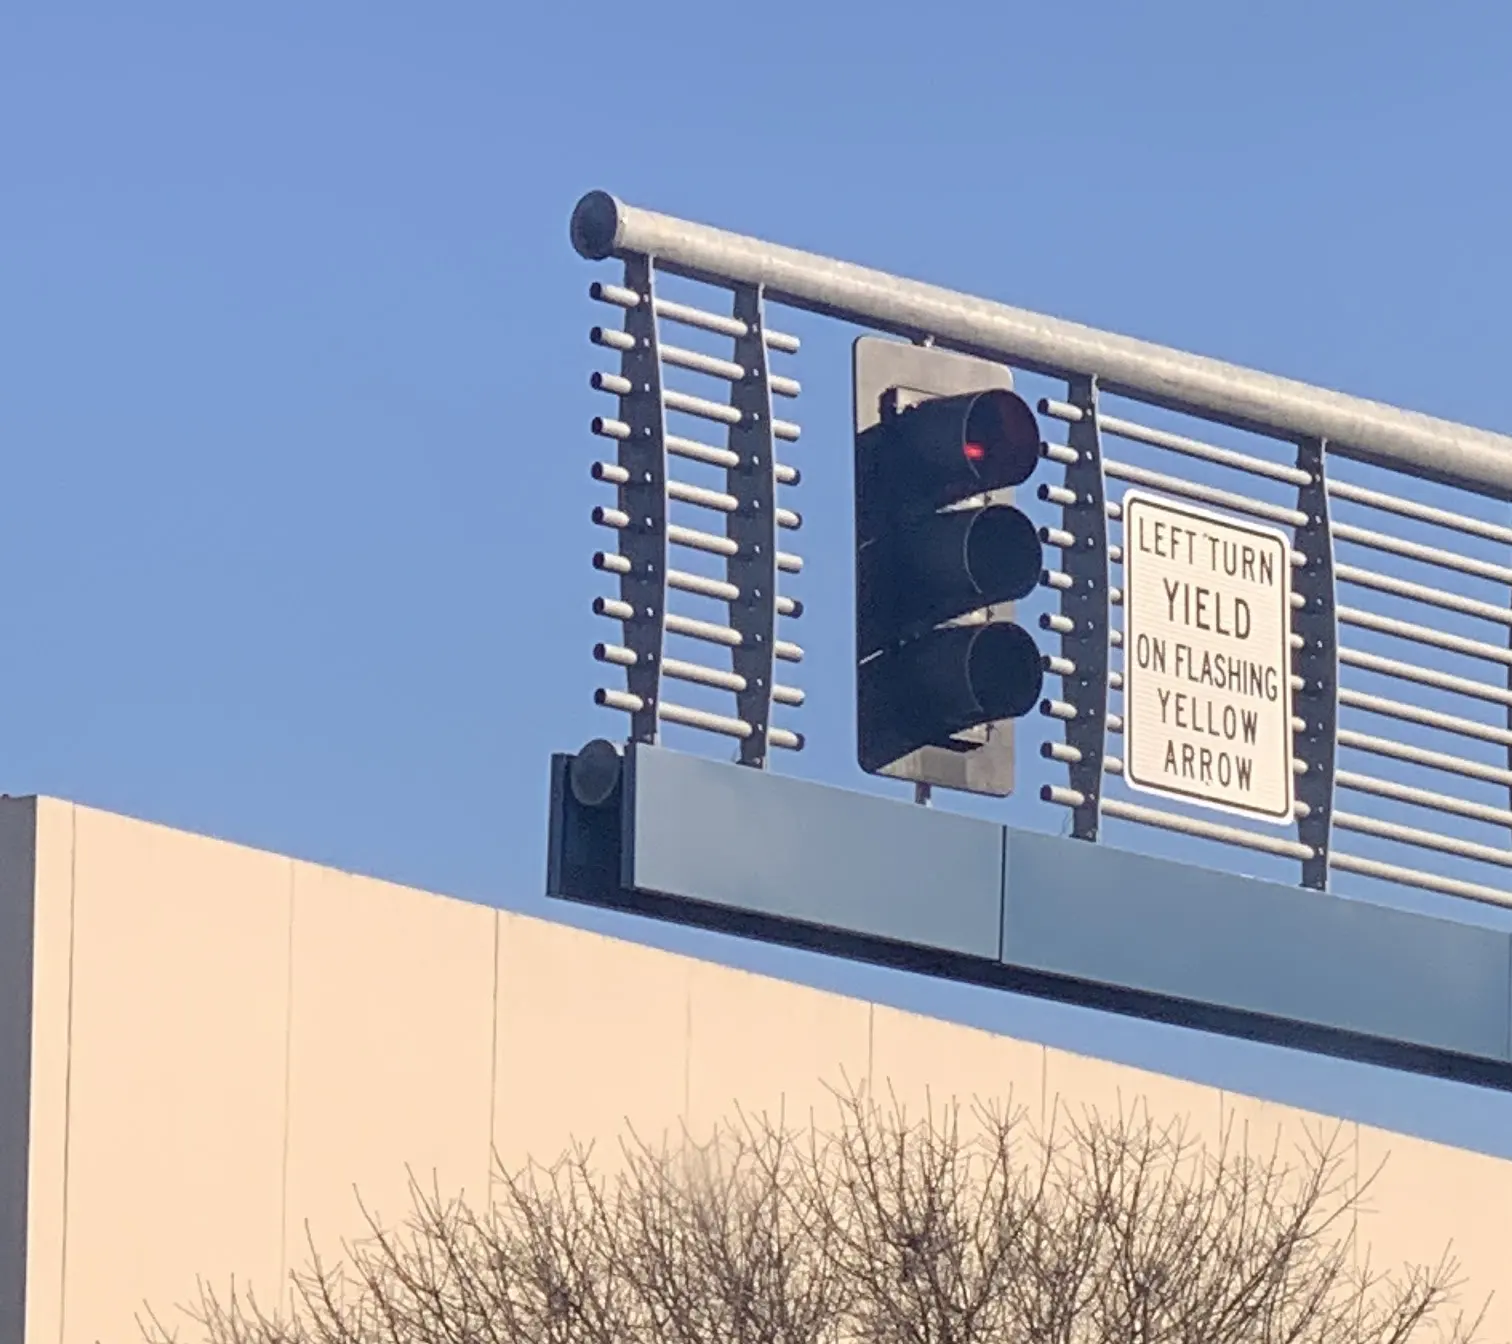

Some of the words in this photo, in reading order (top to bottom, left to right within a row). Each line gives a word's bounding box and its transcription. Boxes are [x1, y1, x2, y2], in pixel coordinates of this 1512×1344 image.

[1139, 516, 1197, 565] LEFT
[1207, 535, 1274, 587] TURN
[1163, 577, 1252, 641] YIELD
[1137, 633, 1167, 675] ON
[1175, 644, 1279, 702] FLASHING
[1157, 687, 1259, 747] YELLOW
[1164, 739, 1253, 792] ARROW
